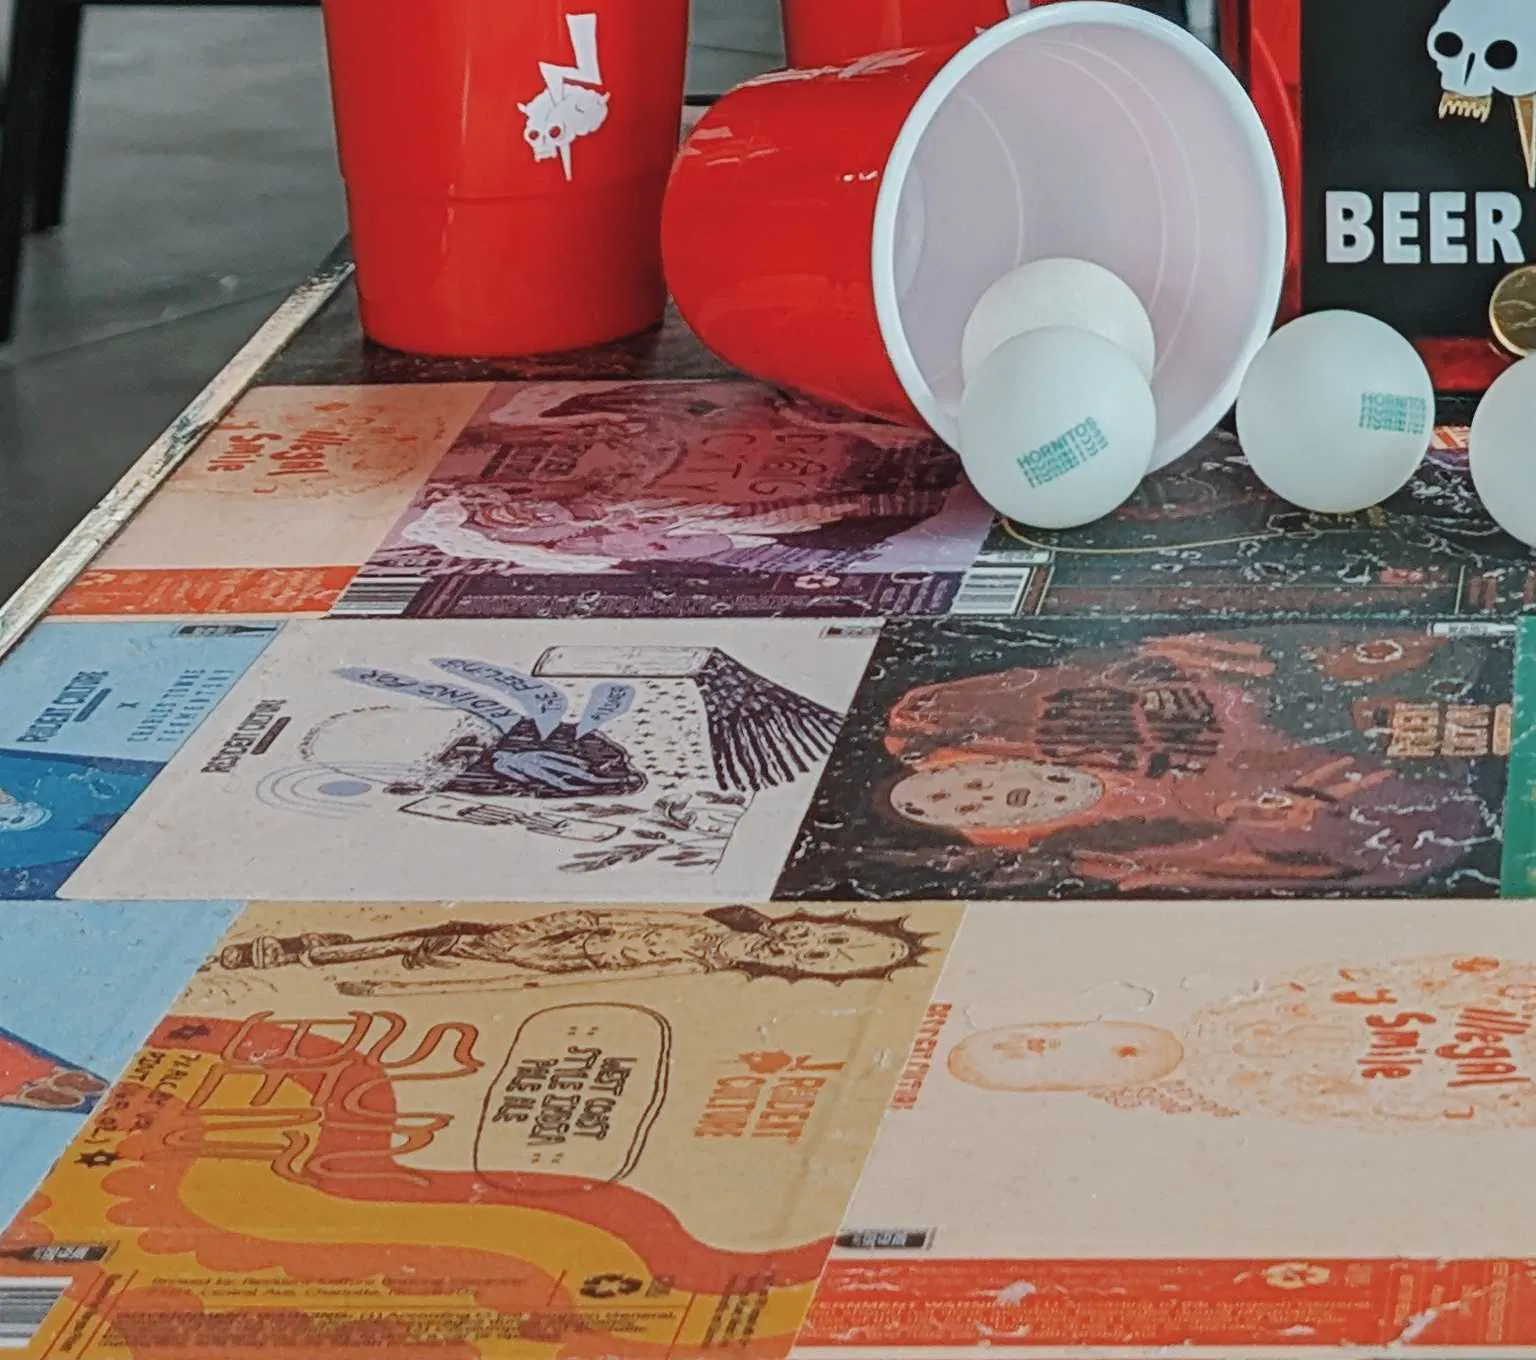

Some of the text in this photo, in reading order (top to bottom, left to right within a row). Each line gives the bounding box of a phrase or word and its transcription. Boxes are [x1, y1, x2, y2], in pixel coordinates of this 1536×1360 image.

[1325, 191, 1523, 264] BEER
[1016, 416, 1104, 477] HORNITOS
[1357, 1012, 1437, 1078] Smile
[492, 1058, 559, 1121] PALE ALE
[527, 1046, 602, 1145] STYLE INDIA
[572, 1098, 616, 1141] COAST
